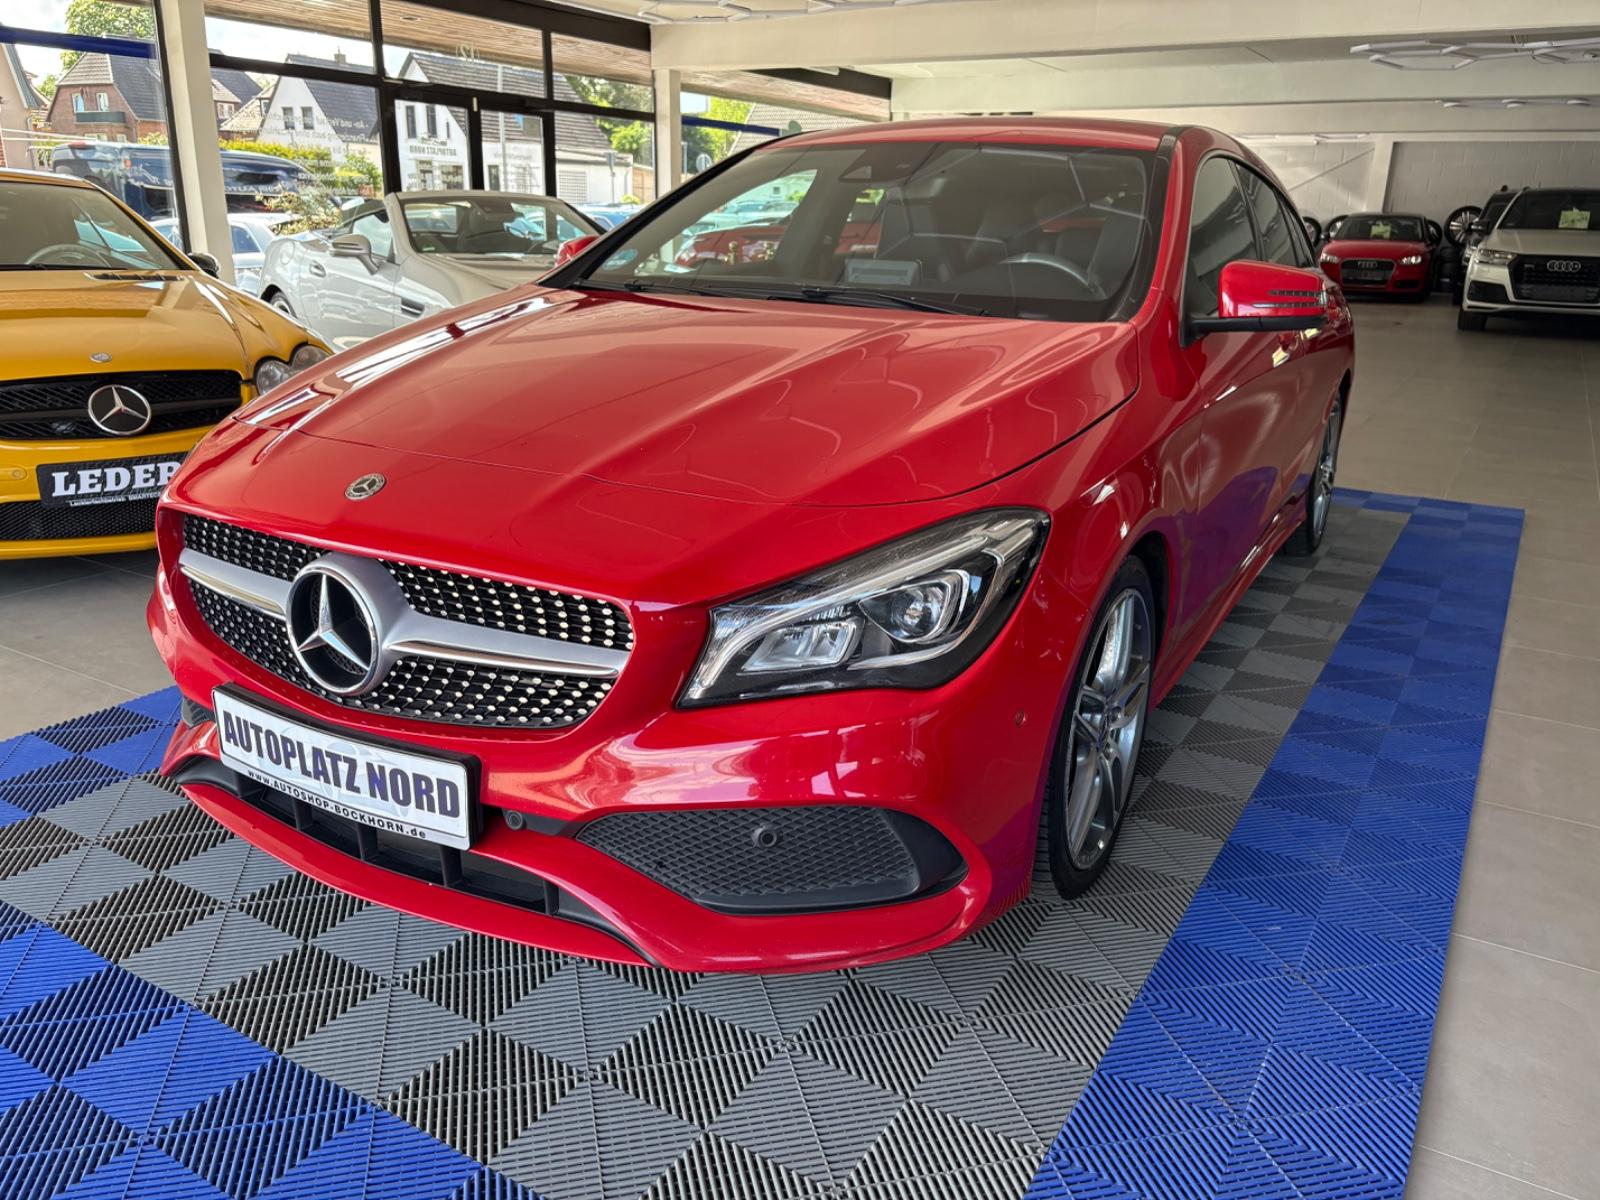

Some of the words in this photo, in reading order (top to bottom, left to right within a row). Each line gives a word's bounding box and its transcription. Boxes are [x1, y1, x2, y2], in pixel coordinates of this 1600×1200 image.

[222, 710, 361, 794] AUTOPLATZ
[366, 762, 460, 819] NORD
[248, 770, 427, 839] www.AUTOSHOP-BOCKHORN.de
